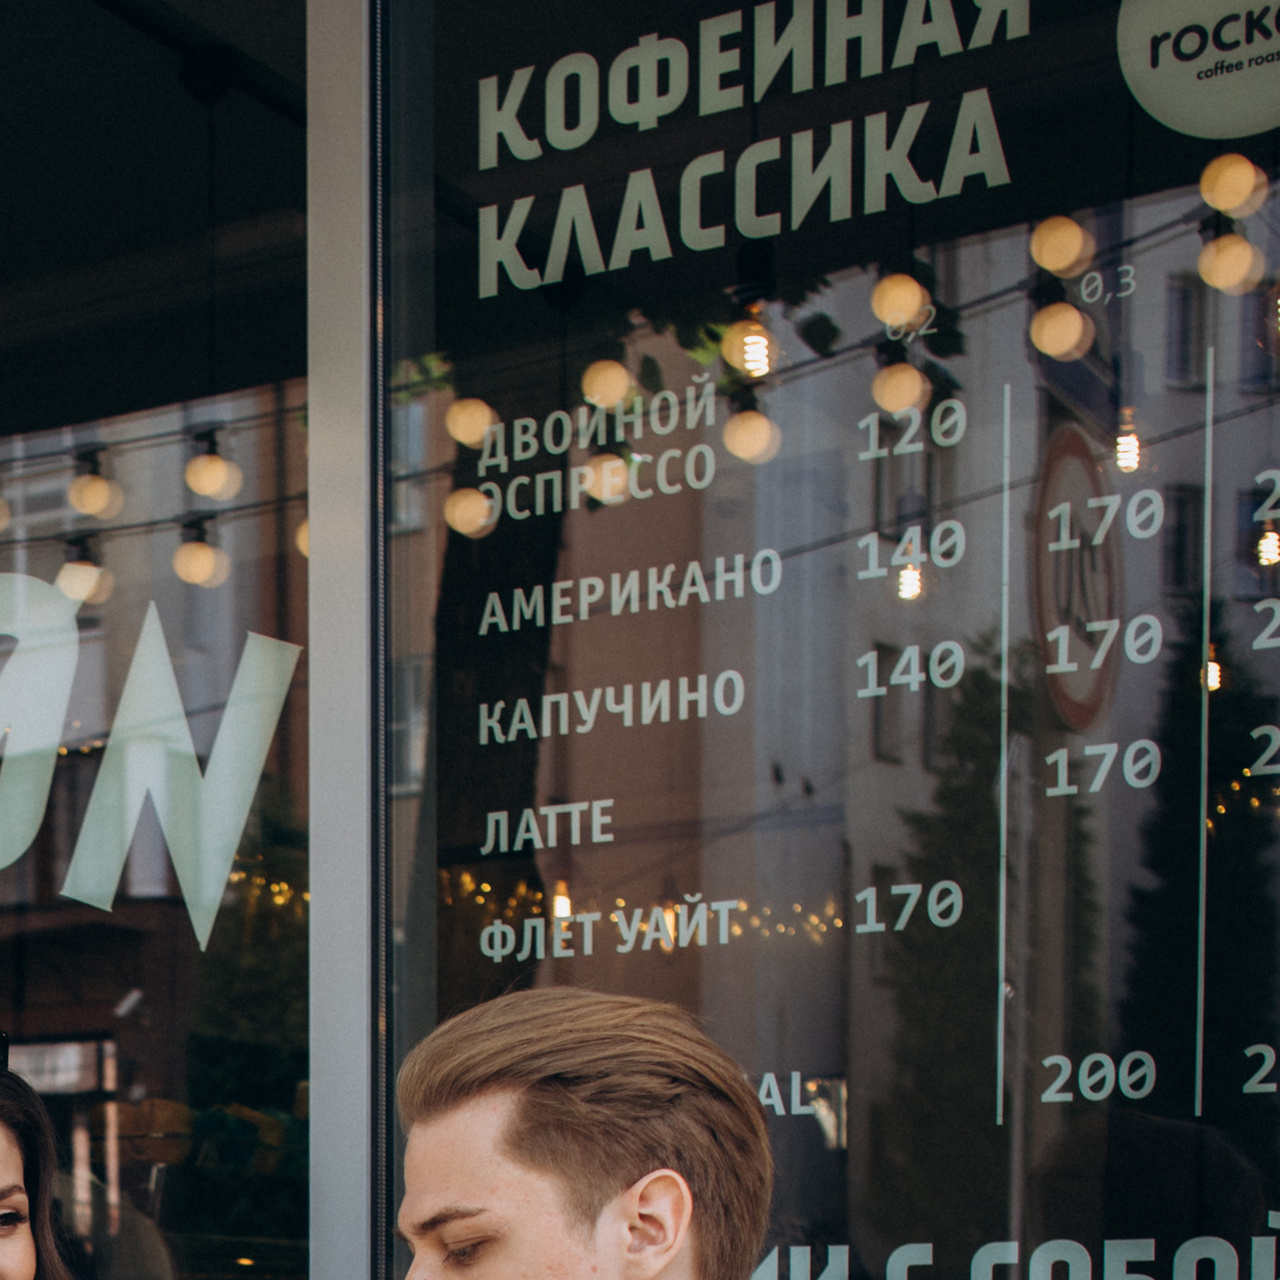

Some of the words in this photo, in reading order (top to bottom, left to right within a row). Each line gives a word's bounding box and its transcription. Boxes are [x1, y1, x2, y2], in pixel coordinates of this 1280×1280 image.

[1197, 60, 1244, 80] coffee
[478, 87, 1012, 299] КЛАССИКА
[884, 305, 939, 343] 0,2
[1080, 265, 1136, 305] 0,3
[477, 372, 717, 477] ДВОЙНОЙ
[477, 444, 717, 525] ЭСПРЕССО
[857, 399, 968, 462] 120
[477, 548, 783, 636] АМЕРИКАНО
[857, 520, 967, 580] 140
[1048, 489, 1165, 553] 170
[479, 669, 745, 745] КАПУЧИНО
[856, 641, 966, 699] 140
[1046, 614, 1164, 674] 170
[480, 799, 615, 856] ЛАТТЕ
[1045, 739, 1162, 797] 170
[480, 911, 602, 963] ФЛЕТ
[614, 893, 739, 954] УАЙТ
[855, 880, 964, 934] 170
[756, 1071, 815, 1116] AL
[1041, 1050, 1156, 1103] 200
